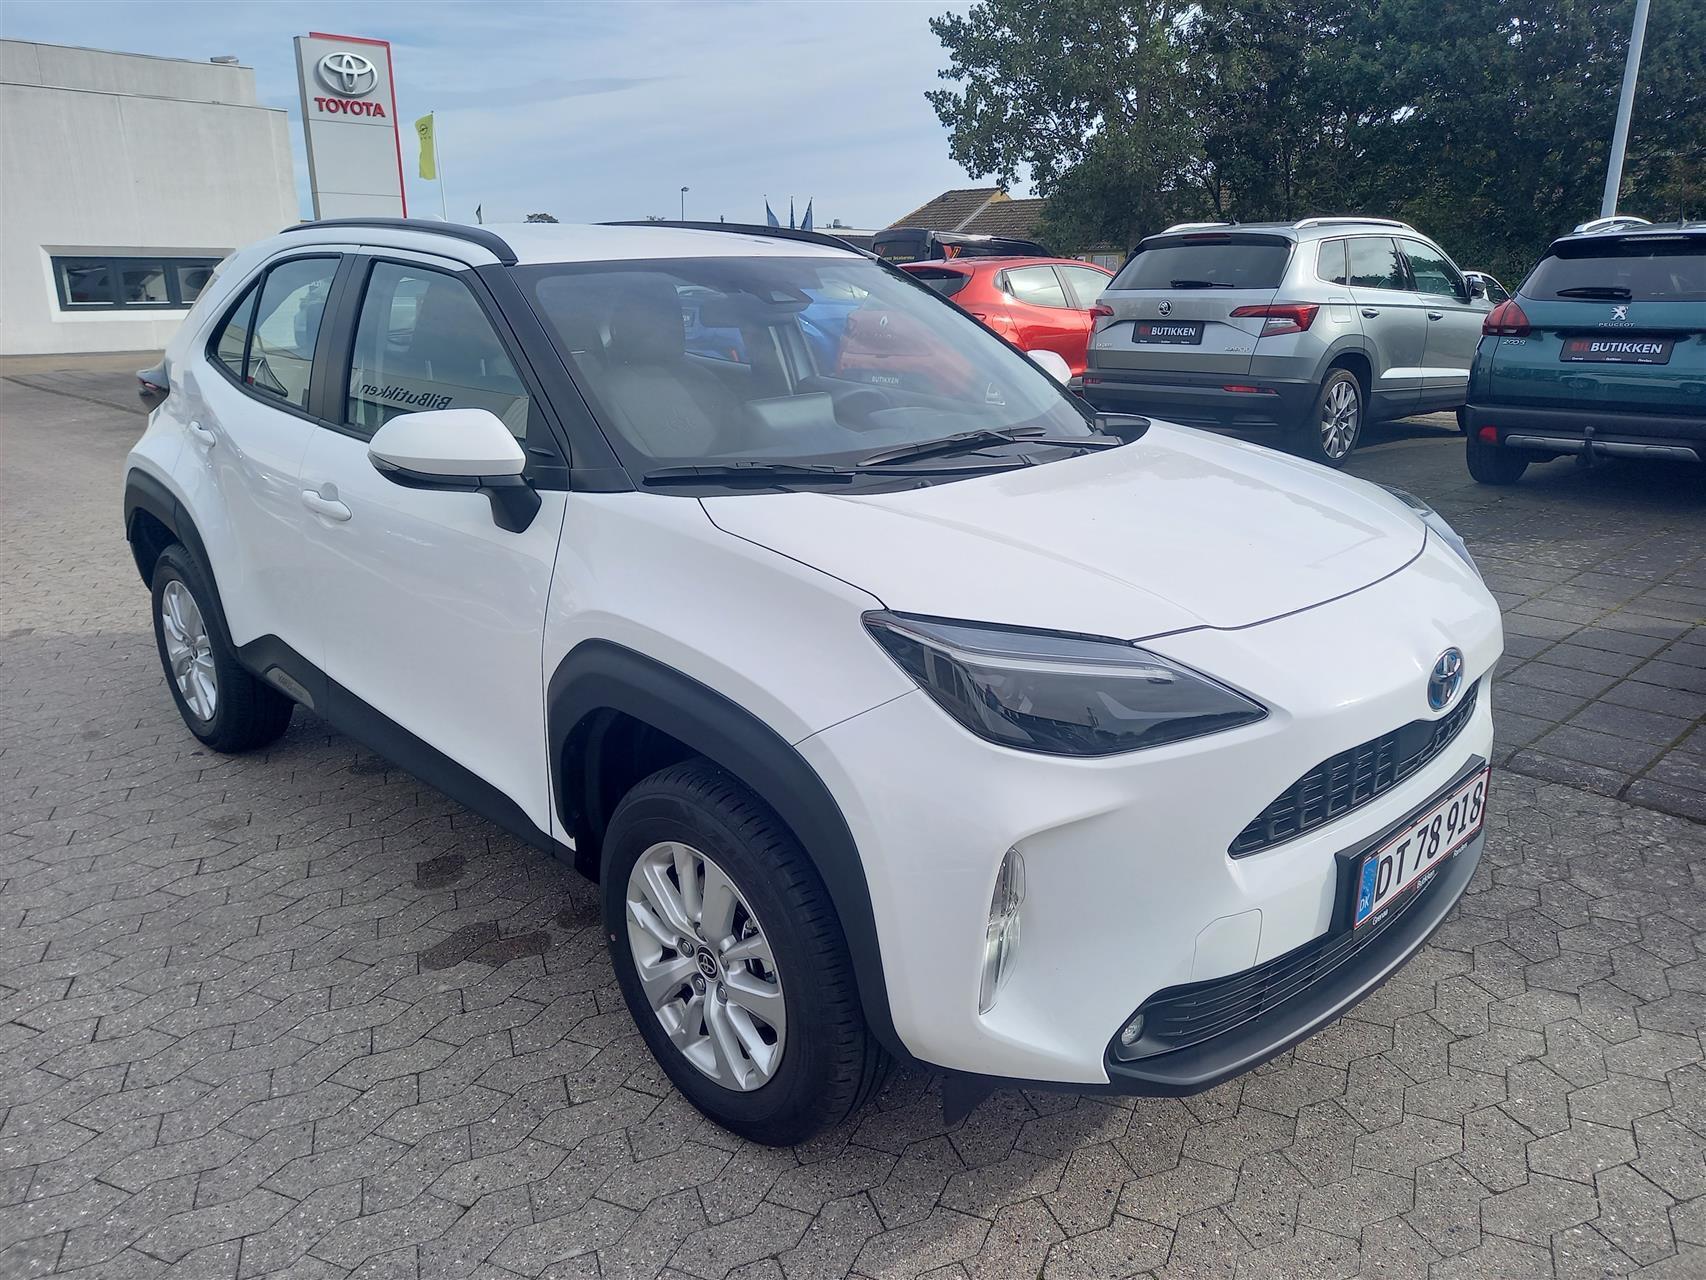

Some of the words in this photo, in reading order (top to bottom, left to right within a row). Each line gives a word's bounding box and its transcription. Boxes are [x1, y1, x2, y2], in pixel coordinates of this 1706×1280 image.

[314, 97, 386, 118] TOYOTA
[1138, 326, 1196, 336] BUTIKKEN
[1374, 838, 1411, 903] DT
[1413, 814, 1442, 871] 78
[1446, 781, 1484, 845] 918
[1358, 893, 1371, 913] DK
